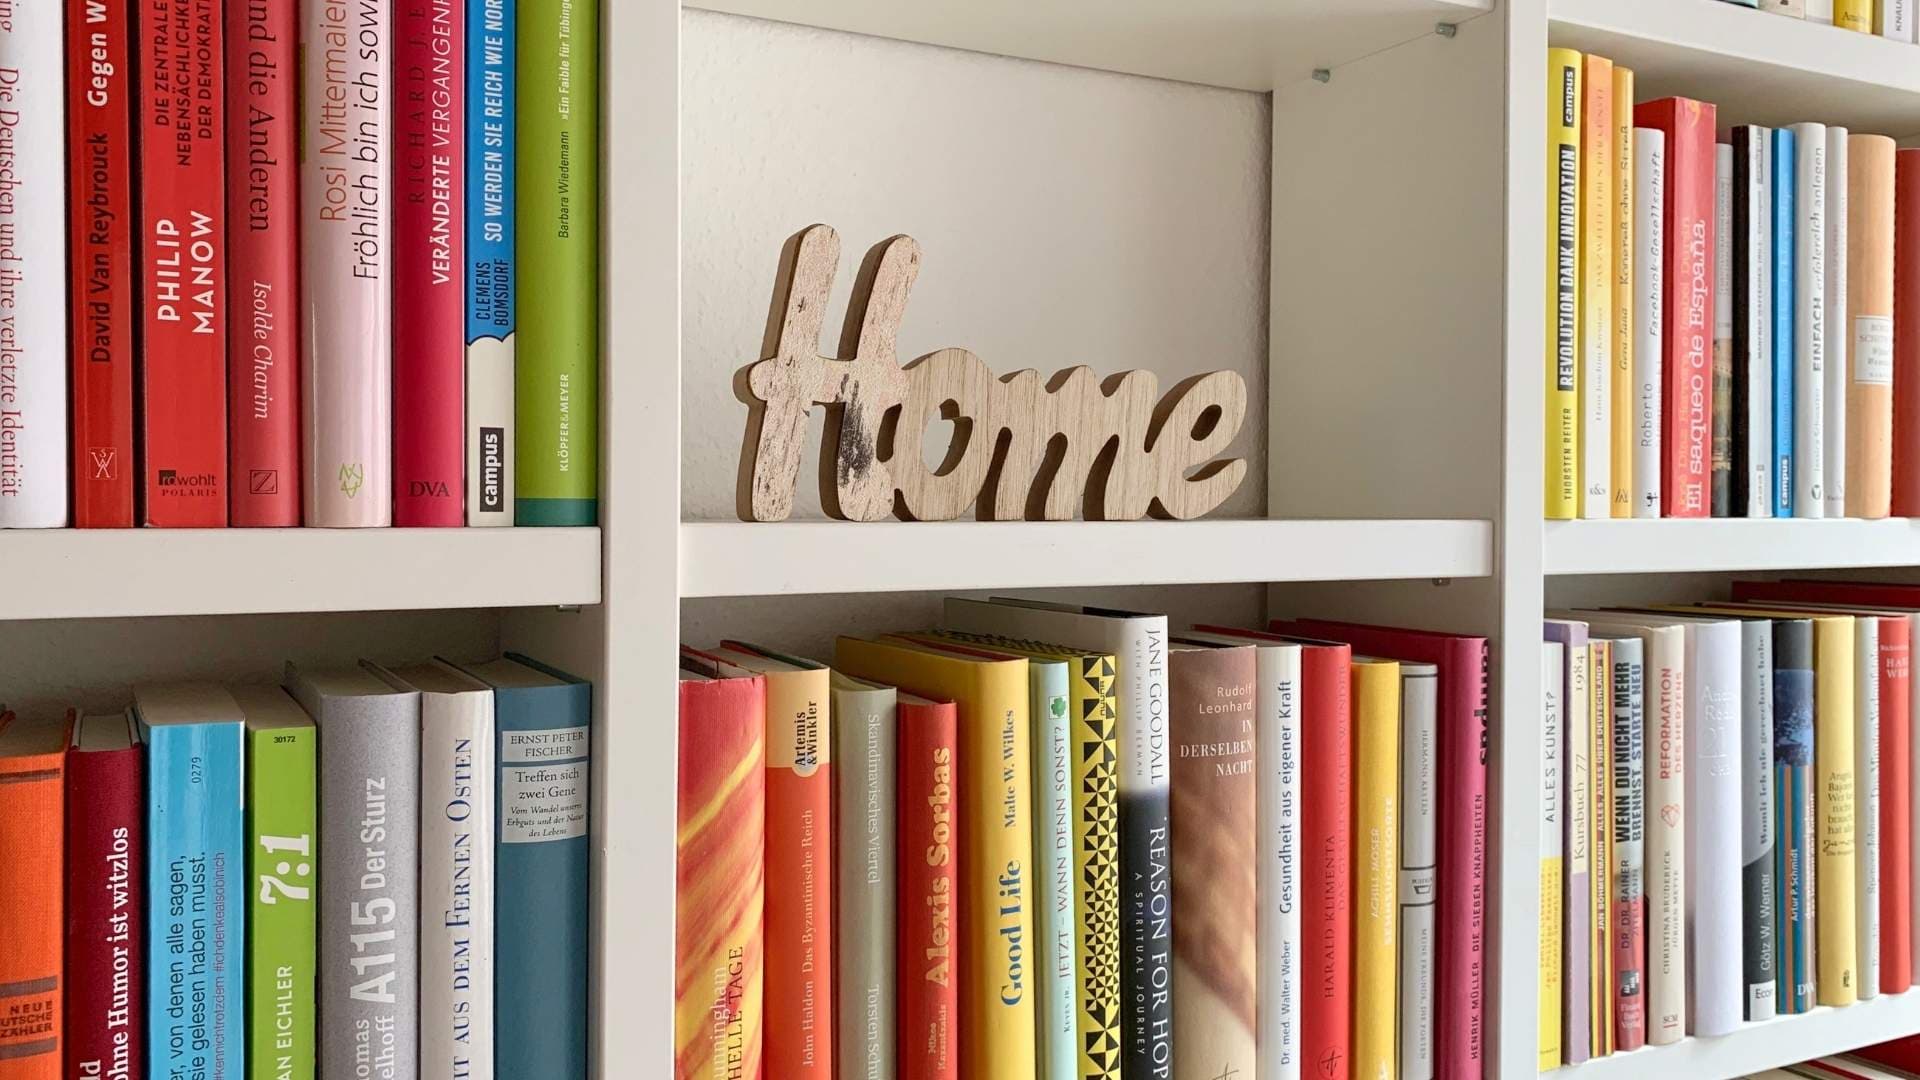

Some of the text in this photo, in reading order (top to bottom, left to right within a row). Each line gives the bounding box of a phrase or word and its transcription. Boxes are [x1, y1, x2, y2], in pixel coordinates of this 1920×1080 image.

[87, 33, 114, 107] Gegen
[154, 2, 170, 126] DIE ZENTRALE
[1564, 70, 1575, 124] campus
[197, 108, 213, 139] DER
[248, 51, 278, 232] die Anderen
[484, 37, 503, 242] SO WERDEN SIE REICH WIE
[319, 166, 347, 221] Rosi
[351, 70, 379, 279] Fröhlich bin ich
[429, 154, 450, 285] VERÄNDERTE
[557, 131, 569, 239] Barbara Wiedemann
[87, 133, 115, 363] David Van Reybrouck
[156, 219, 181, 321] PHILIP
[190, 210, 215, 334] MANOW
[475, 261, 491, 320] CLEMENS
[494, 258, 509, 326] BOMSDORF
[1560, 149, 1576, 387] REVOLUTION DANK INNOVATION
[1649, 151, 1661, 337] Facebook-Gesellschaft
[0, 110, 24, 497] Deutschen und ihre verletzte Identität
[253, 280, 274, 419] Isolde Charim
[1813, 298, 1823, 372] EINFACH
[733, 223, 1248, 522] Home
[1640, 383, 1654, 447] Roberto
[1686, 219, 1709, 511] El saqueo de España
[161, 488, 218, 497] POLARIS
[408, 480, 450, 497] DVA
[484, 433, 502, 507] campus
[1562, 407, 1573, 500] THORSTEN REITER
[1781, 459, 1790, 506] campus
[273, 735, 296, 745] 30172
[510, 732, 585, 745] ERNST PETER
[794, 711, 806, 767] Artemis
[1146, 630, 1167, 785] JANE GOODALL
[1199, 700, 1253, 714] Leonhard
[1217, 684, 1253, 697] Rudolf
[1631, 664, 1642, 761] STARTE NEU
[1659, 667, 1671, 780] REFORMATION
[1674, 671, 1683, 774] DES HERZENS
[190, 756, 203, 784] 0279
[515, 770, 557, 783] Treffen
[519, 786, 577, 800] zwei Gene
[525, 746, 573, 757] FISCHER
[867, 713, 881, 884] Skandinavisches Viertel
[1278, 679, 1295, 915] Gesundheit aus eigener Kraft
[1544, 691, 1556, 823] ALLES KUNST?
[1573, 654, 1587, 860] Kursbuch 77 1984
[1614, 661, 1631, 843] WENN DU NICHT MEHR
[926, 747, 950, 988] Alexis Sorbas
[1054, 725, 1068, 912] WANN DENN SONST?
[1790, 848, 1800, 885] Schmidt
[259, 833, 311, 905] 7:1
[350, 776, 397, 1005] A115 Der Sturz
[445, 738, 473, 1045] AUS DEM FERNEN OSTEN
[1620, 859, 1630, 903] RAINER
[1790, 897, 1799, 922] Artur
[105, 826, 130, 1030] Humor ist witzlos
[165, 855, 189, 1059] von denen alle sagen,
[187, 851, 210, 1052] gelesen haben musst.
[801, 808, 814, 1031] Haldon Reich
[1000, 859, 1024, 1007] Good Life
[1323, 928, 1335, 999] HARALD
[1471, 793, 1483, 1060] HENRIK MÜLLER DIE SIEBEN KNAPPHEITEN
[1597, 913, 1605, 931] JAN
[1662, 918, 1670, 975] CHRISTINA
[1760, 873, 1771, 971] Götz W. Werner
[276, 966, 294, 1050] EICHLER
[727, 945, 744, 1006] TAGE
[866, 984, 881, 1041] Torsten
[1135, 892, 1146, 1055] SPIRITUAL JOURNEY
[1151, 951, 1168, 1011] FOR
[1280, 939, 1291, 1065] Dr. med. Walter Weber
